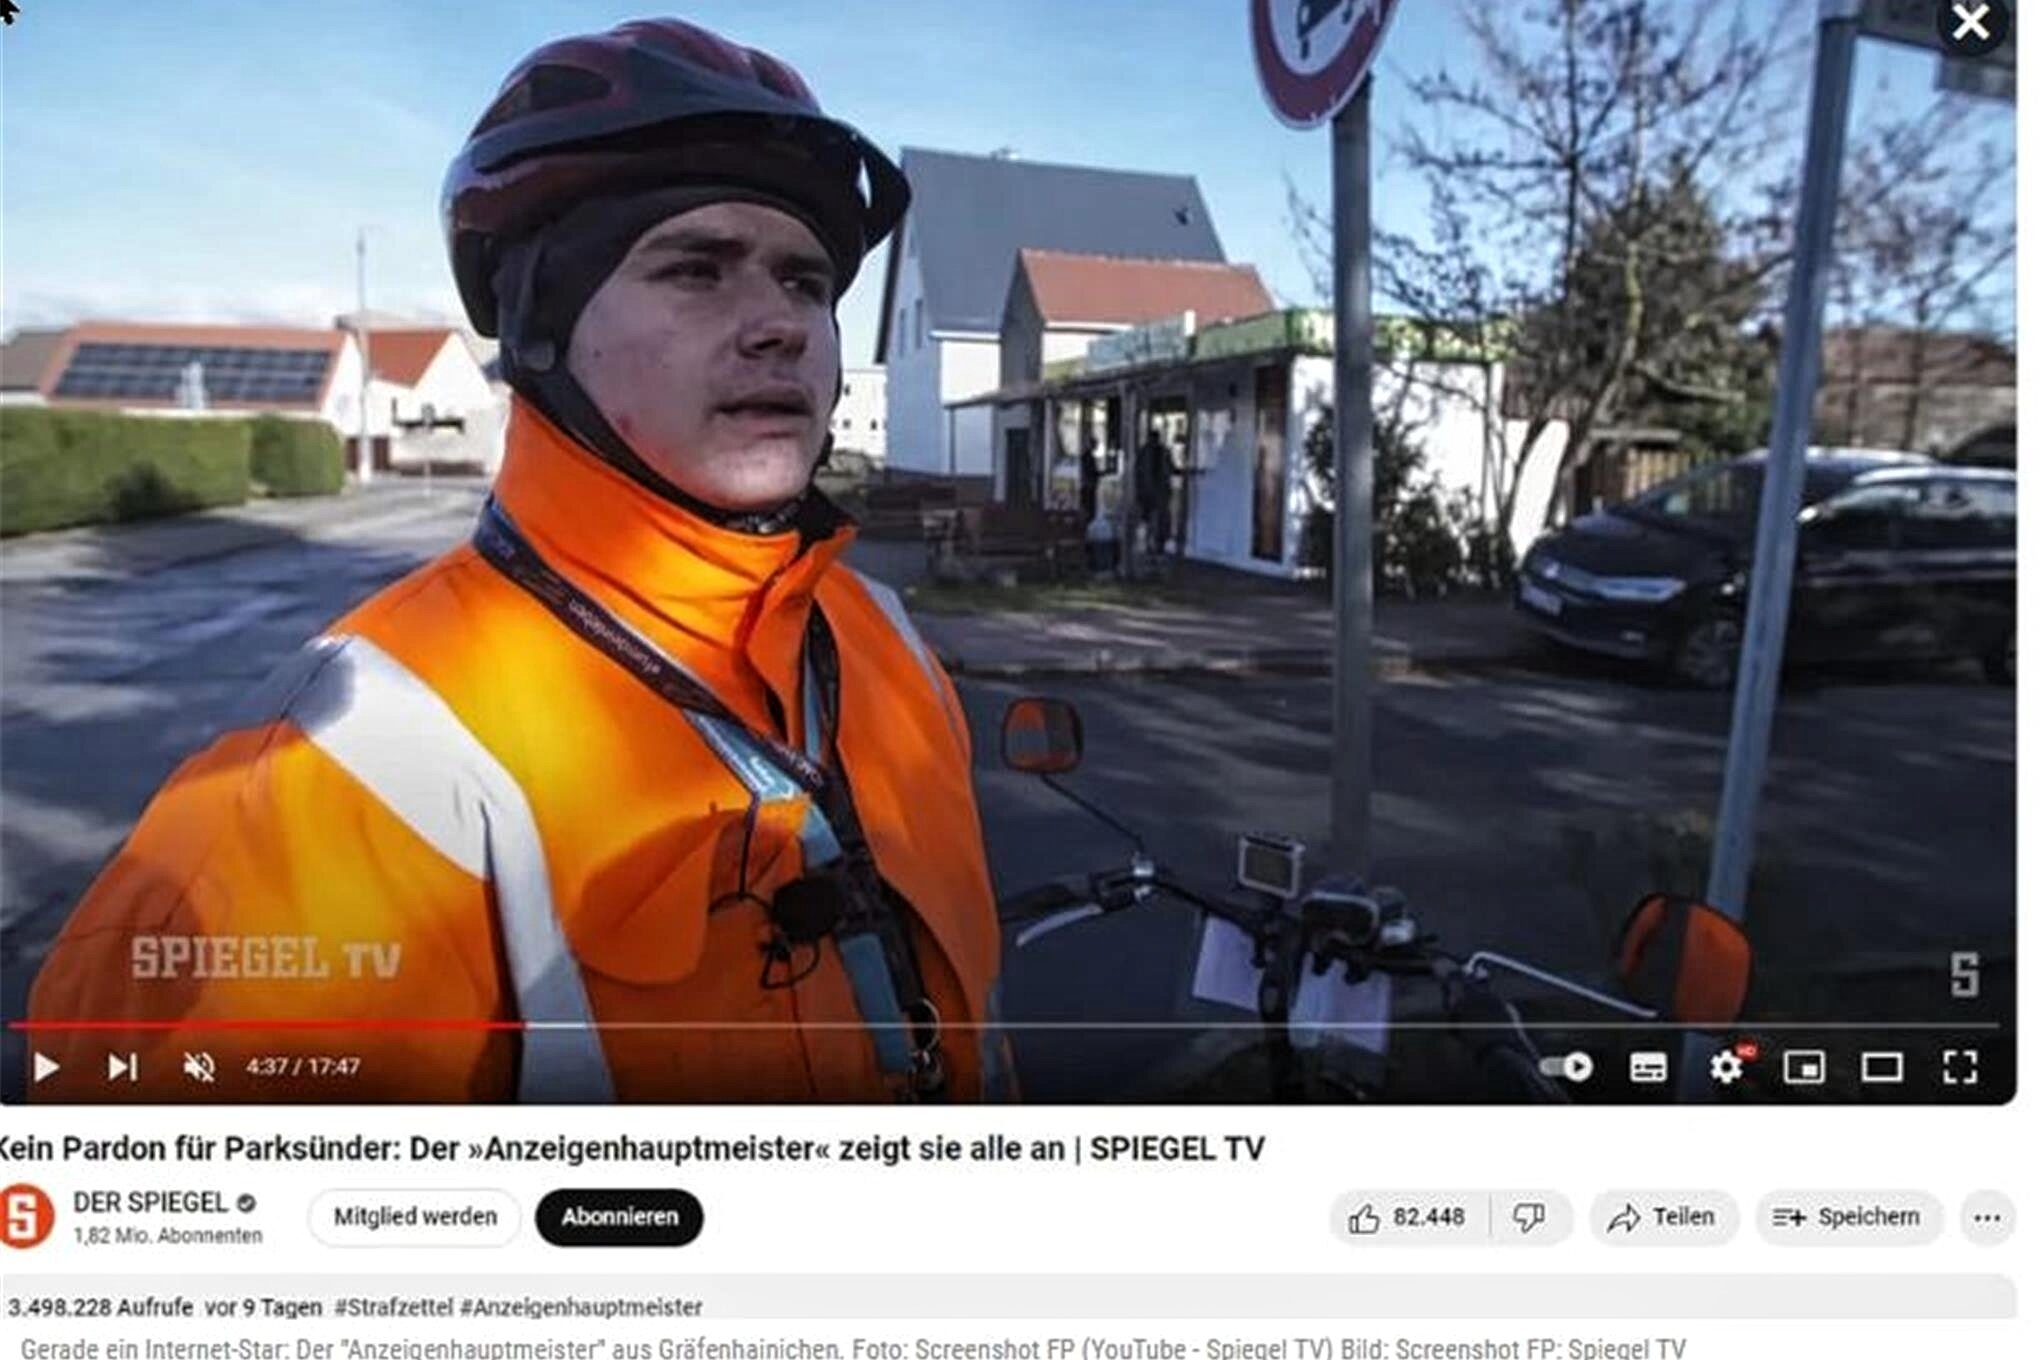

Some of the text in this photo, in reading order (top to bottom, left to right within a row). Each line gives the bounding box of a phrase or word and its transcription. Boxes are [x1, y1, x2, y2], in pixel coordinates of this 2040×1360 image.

[246, 1057, 286, 1076] 4:37
[309, 1057, 362, 1076] 17:47
[62, 1133, 167, 1162] Pardon
[174, 1133, 218, 1162] für
[224, 1133, 401, 1162] Parksünder:
[410, 1134, 462, 1162] Der
[468, 1133, 831, 1168] »Anzeigenhauptmeister«
[838, 1133, 912, 1168] zeigt
[919, 1134, 963, 1162] sie
[969, 1133, 1023, 1162] alle
[1029, 1139, 1066, 1162] an
[1090, 1134, 1218, 1162] SPIEGEL
[1223, 1134, 1267, 1162] TV
[73, 1190, 230, 1214] DER SPIEGEL
[334, 1205, 498, 1231] Mitglied werden
[561, 1205, 680, 1226] Abonnieren
[1393, 1206, 1466, 1227] 82.448
[1652, 1205, 1715, 1226] Teilen
[1818, 1205, 1921, 1231] Speichern
[74, 1226, 263, 1247] 1,82 Mio. Abonnenten
[8, 1296, 703, 1320] 3.498.228 Aufrufe vor 9 Tagen #Strafzettel #Anzeigenhauptmeister
